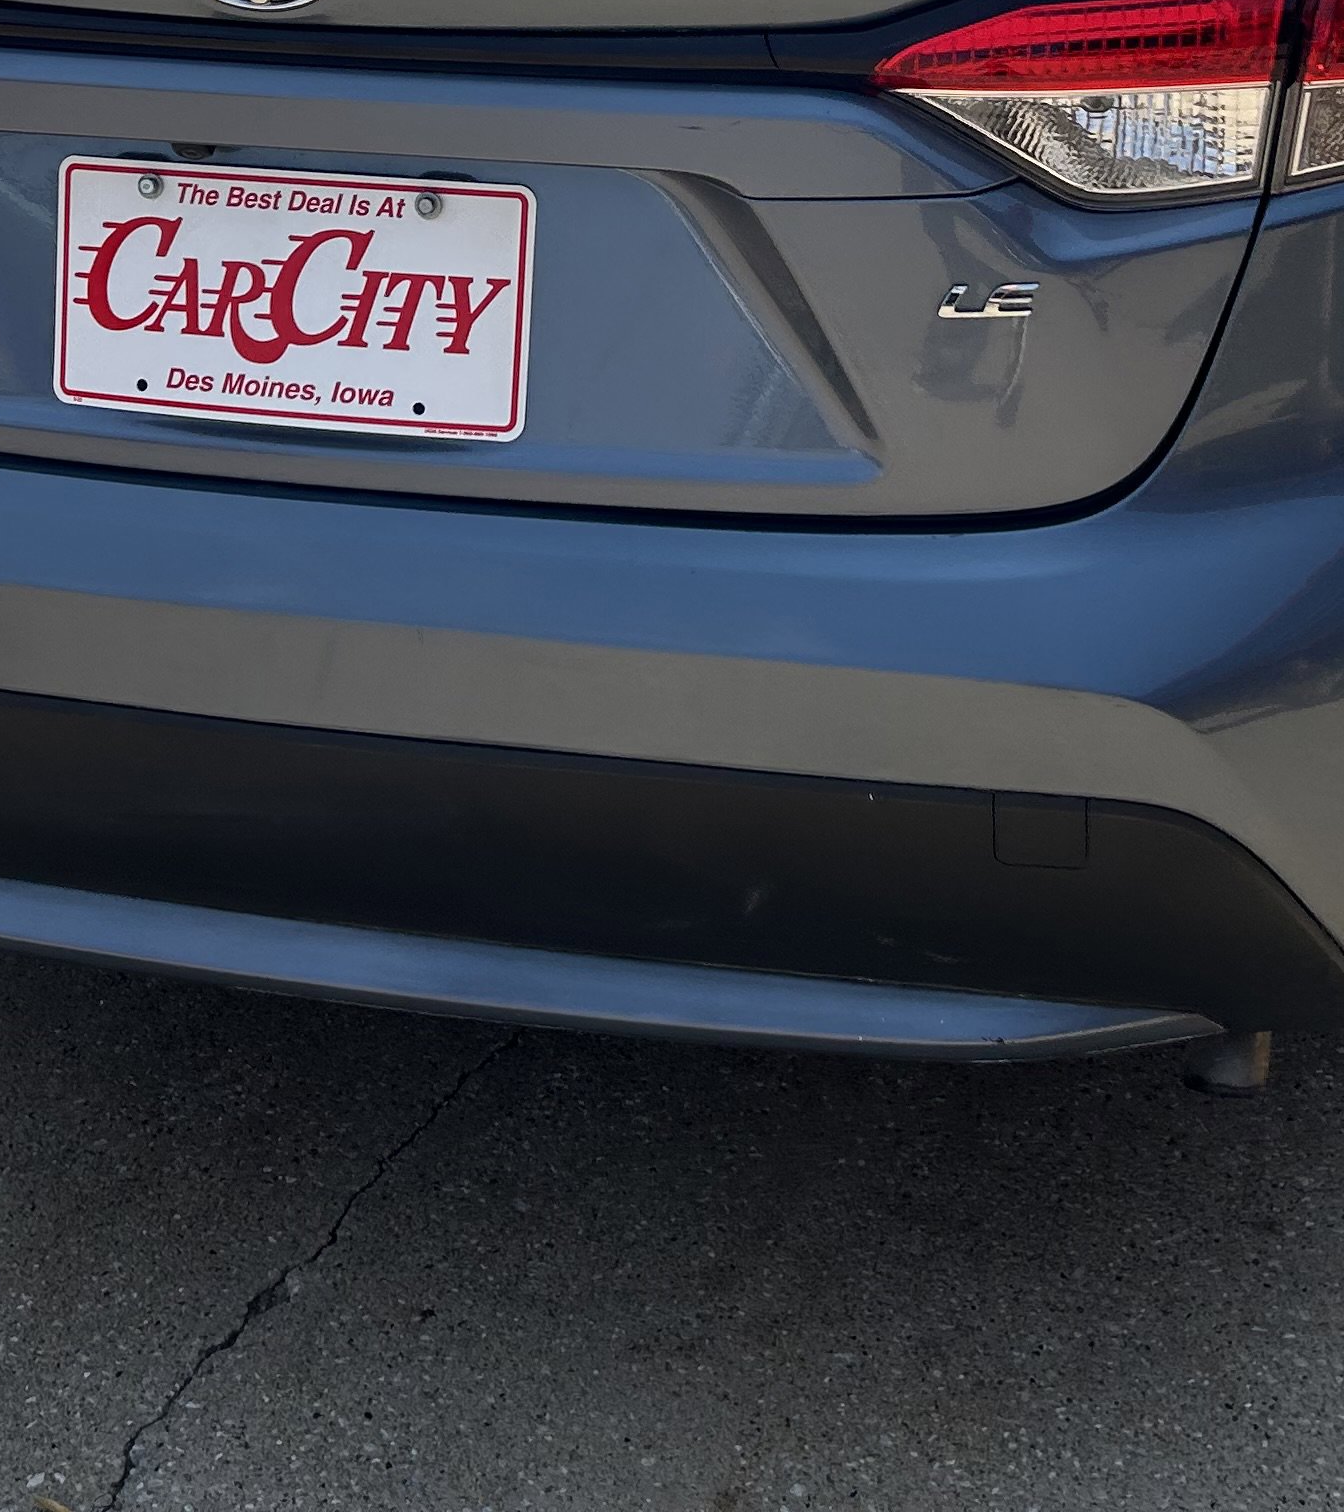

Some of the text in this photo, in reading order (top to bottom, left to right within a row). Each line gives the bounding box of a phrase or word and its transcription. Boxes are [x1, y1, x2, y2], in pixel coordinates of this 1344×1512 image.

[177, 182, 406, 219] The Best Deal Is At
[937, 281, 1040, 318] LE
[166, 367, 395, 407] Des Moines, Iowa
